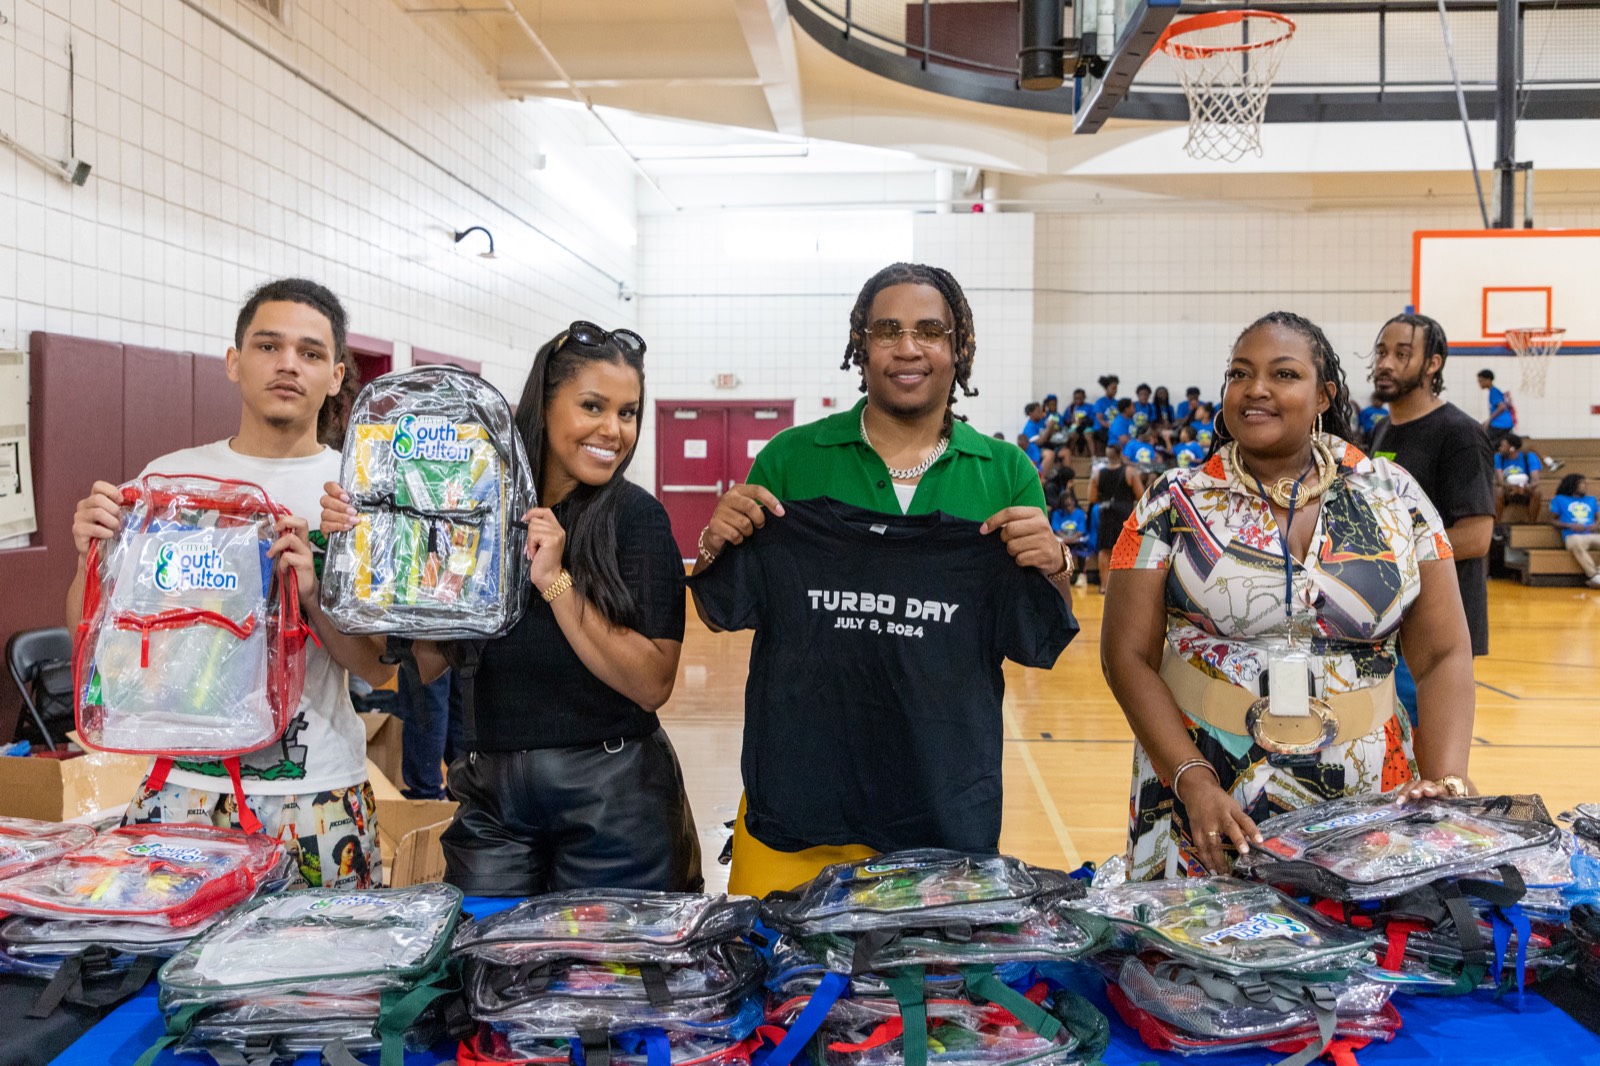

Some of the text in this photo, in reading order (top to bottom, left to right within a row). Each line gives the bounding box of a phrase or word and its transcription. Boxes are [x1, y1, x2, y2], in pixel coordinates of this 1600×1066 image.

[415, 440, 468, 460] Fulton
[180, 568, 237, 589] Fulton
[807, 589, 960, 623] TURBO DAY
[834, 617, 924, 638] JULY 8, 2024
